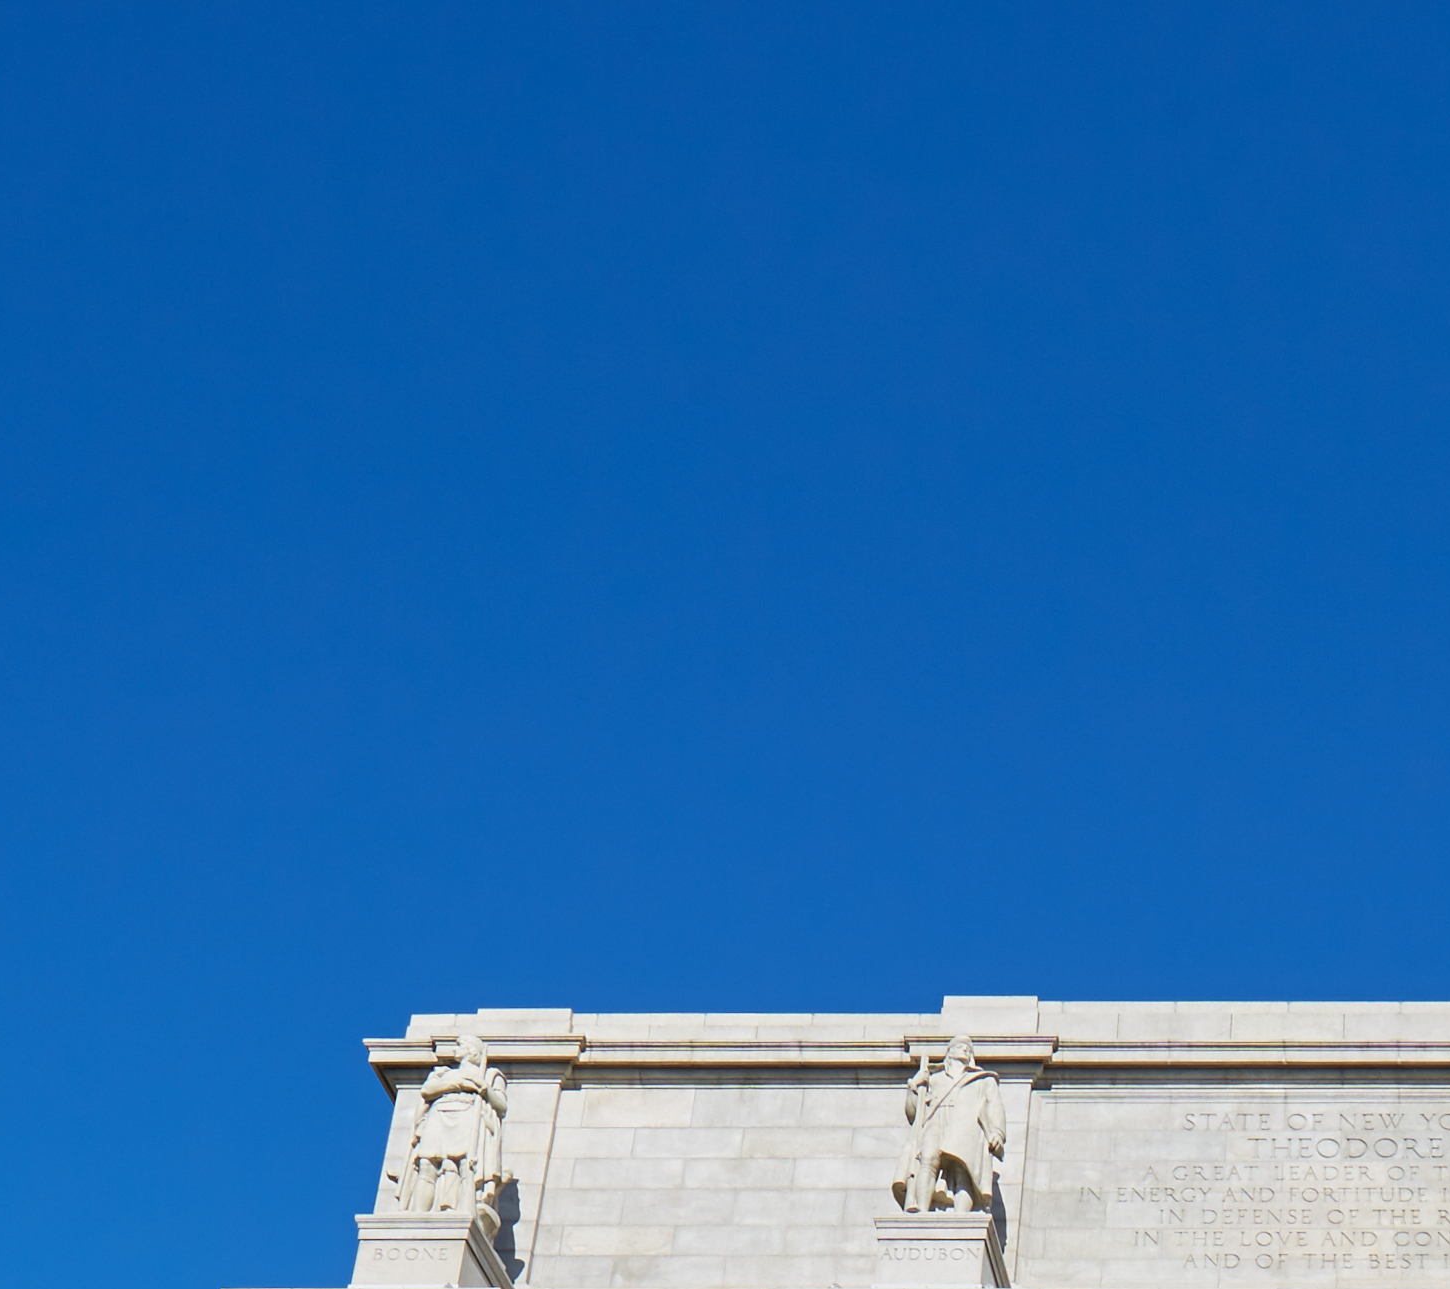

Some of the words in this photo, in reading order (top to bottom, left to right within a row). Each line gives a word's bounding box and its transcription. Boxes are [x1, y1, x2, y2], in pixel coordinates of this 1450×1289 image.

[1183, 1113, 1272, 1131] STATE
[1287, 1113, 1325, 1131] OF
[1338, 1113, 1406, 1131] NEW
[1247, 1137, 1444, 1159] THEODORE
[1143, 1166, 1159, 1182] A
[1172, 1166, 1259, 1182] GREAT
[1275, 1166, 1373, 1182] LEADER
[1387, 1166, 1420, 1182] OF
[1079, 1187, 1102, 1203] IN
[1118, 1187, 1211, 1203] ENERGY
[1222, 1187, 1275, 1203] AND
[1289, 1187, 1428, 1203] FORTITUDE
[1159, 1209, 1184, 1225] IN
[1202, 1209, 1312, 1225] DEFENSE
[1326, 1209, 1359, 1225] OF
[1372, 1209, 1420, 1225] THE
[1134, 1231, 1159, 1247] IN
[1174, 1231, 1224, 1247] THE
[1239, 1231, 1308, 1247] LOVE
[1321, 1231, 1377, 1247] AND
[373, 1247, 449, 1261] BOONE
[880, 1247, 981, 1261] AUDUBON
[1182, 1253, 1241, 1269] AND
[1255, 1253, 1288, 1269] OF
[1303, 1253, 1353, 1269] THE
[1368, 1253, 1429, 1269] BEST
